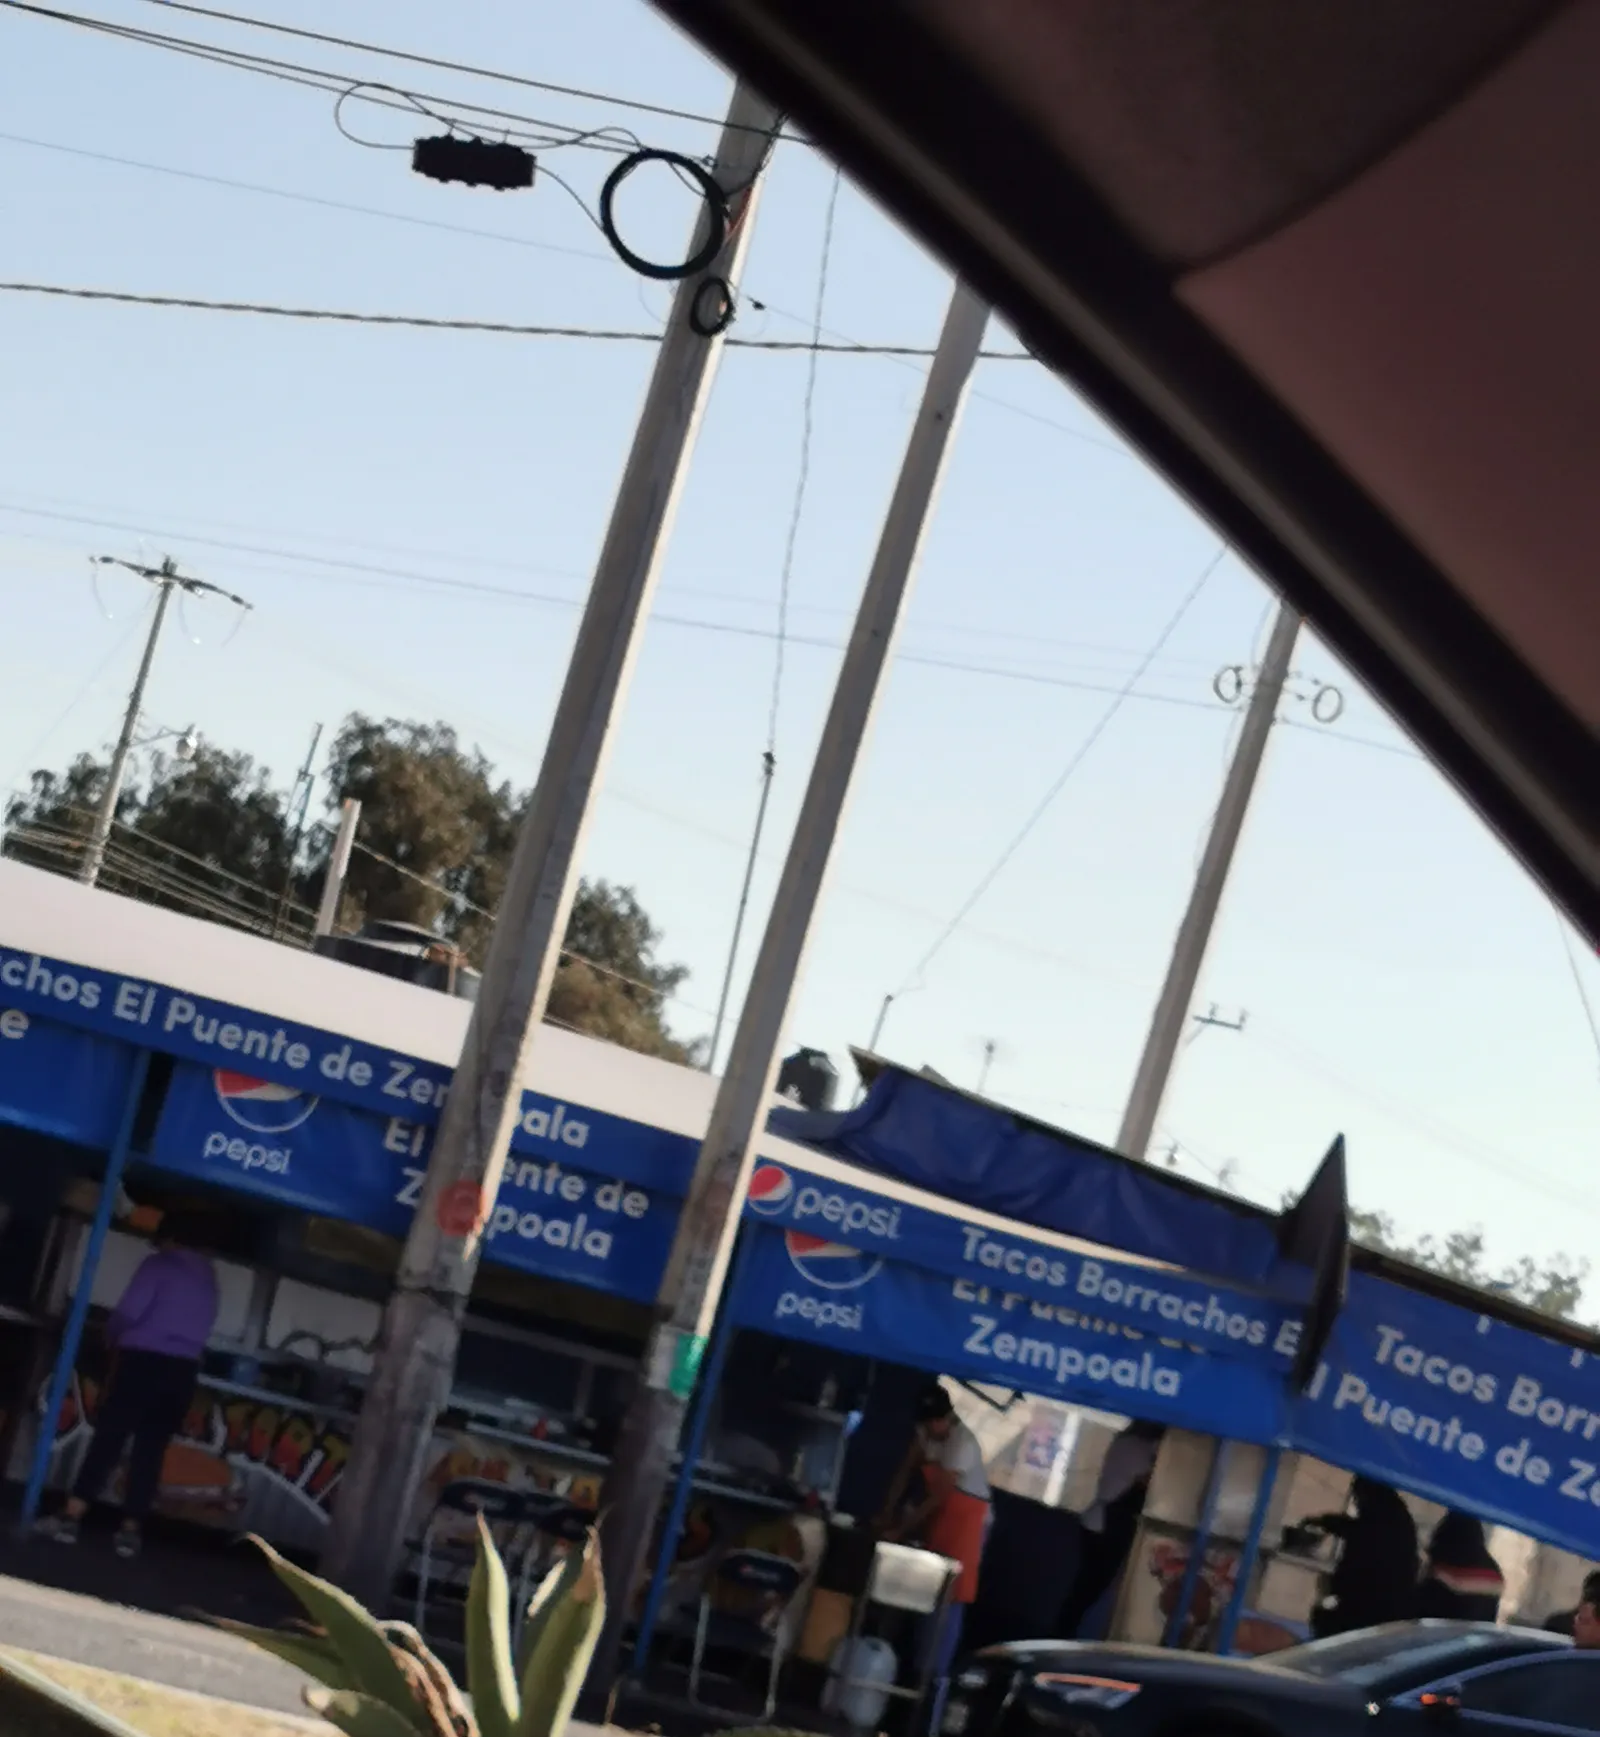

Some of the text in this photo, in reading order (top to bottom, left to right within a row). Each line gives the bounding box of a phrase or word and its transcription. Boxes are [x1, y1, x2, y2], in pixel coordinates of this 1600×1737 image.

[0, 955, 102, 1009] chos
[113, 980, 156, 1024] El
[163, 997, 311, 1069] Puente
[320, 1046, 373, 1086] de
[0, 1009, 30, 1039] e
[203, 1130, 291, 1175] pepsi
[384, 1116, 425, 1157] El
[594, 1180, 650, 1219] de
[774, 1292, 864, 1332] pepsi
[793, 1187, 1304, 1356] pepsi Tacos Borrachos E
[963, 1314, 1181, 1397] Zempoala
[1375, 1323, 1498, 1403] Tacos
[1506, 1374, 1600, 1441] Borr
[1332, 1372, 1486, 1461] Puente
[1495, 1437, 1551, 1485] de
